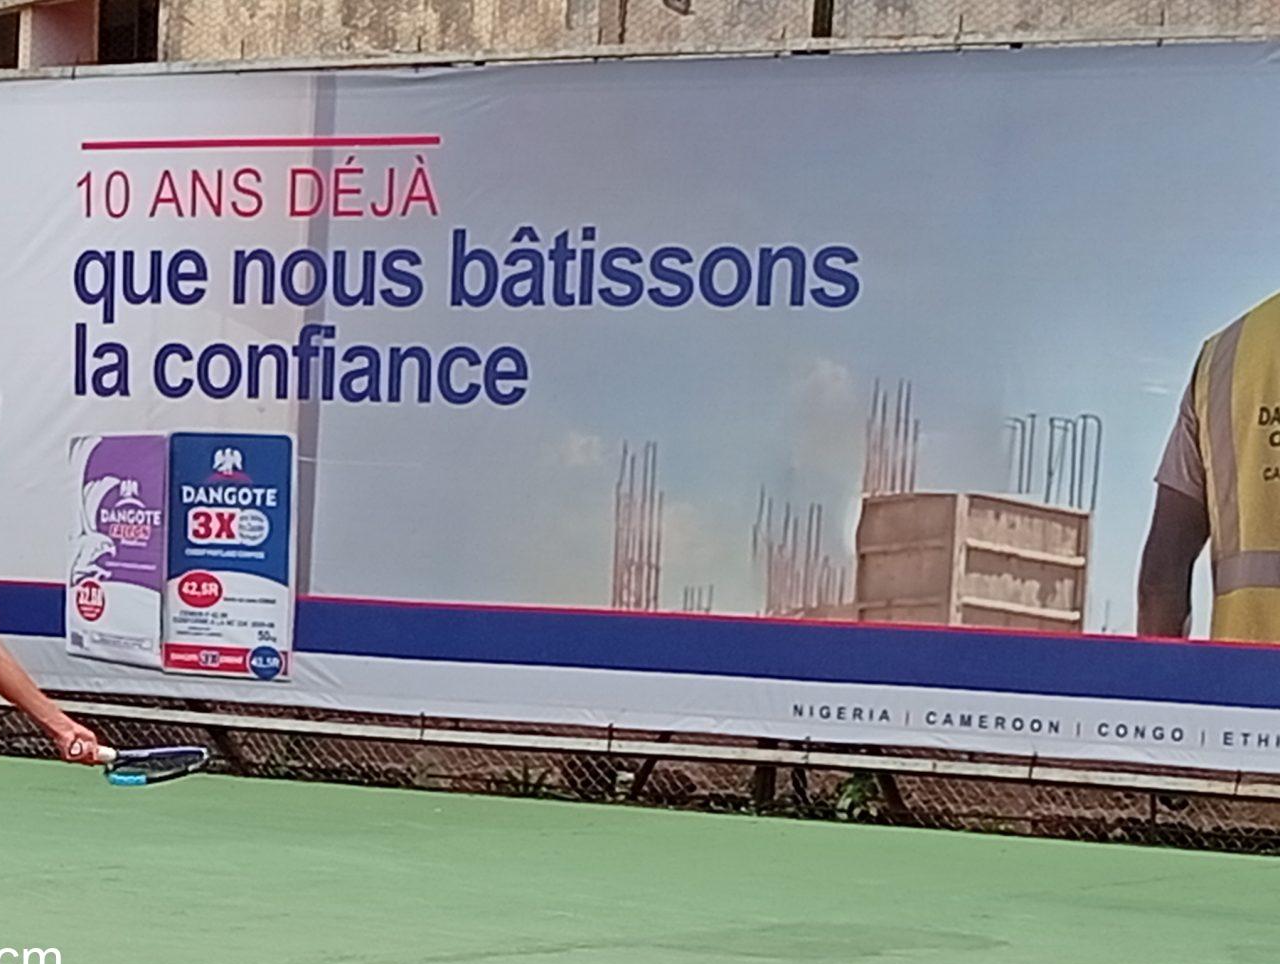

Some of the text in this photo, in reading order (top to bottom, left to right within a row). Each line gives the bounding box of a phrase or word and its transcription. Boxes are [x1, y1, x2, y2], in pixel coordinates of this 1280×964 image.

[76, 155, 439, 218] 10 ANS DÉJÀ
[74, 226, 860, 324] que nous bâtissons
[74, 323, 529, 405] la confiance
[101, 508, 162, 526] DANGOTE
[182, 485, 278, 507] DANGOTE
[193, 511, 236, 540] 3X
[793, 703, 1280, 748] NIGERIA CAMEROON CONGO ETHI
